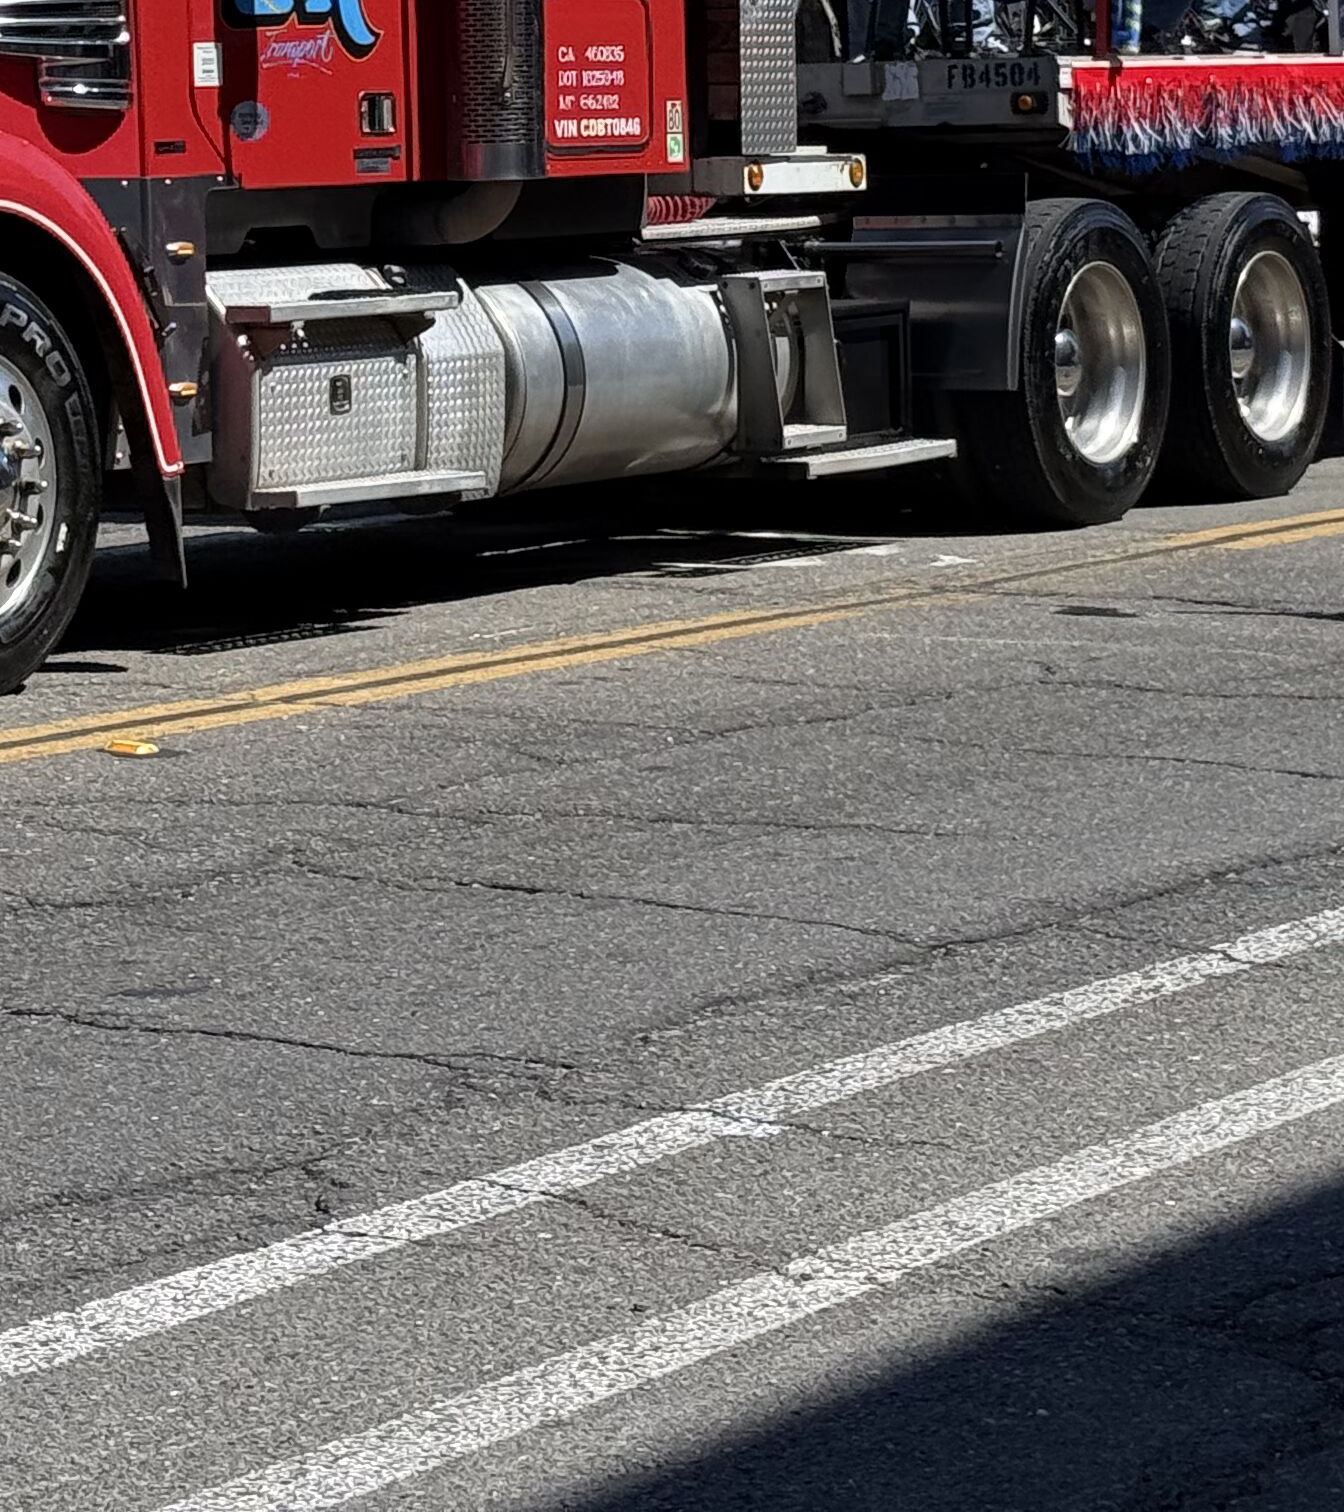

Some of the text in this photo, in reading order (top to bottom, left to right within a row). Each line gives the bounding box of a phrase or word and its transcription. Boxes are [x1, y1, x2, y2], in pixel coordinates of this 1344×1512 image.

[261, 28, 334, 67] Transport
[558, 46, 576, 63] CA
[558, 70, 577, 87] DOT
[946, 61, 1042, 89] FB4504
[554, 119, 577, 138] VIN
